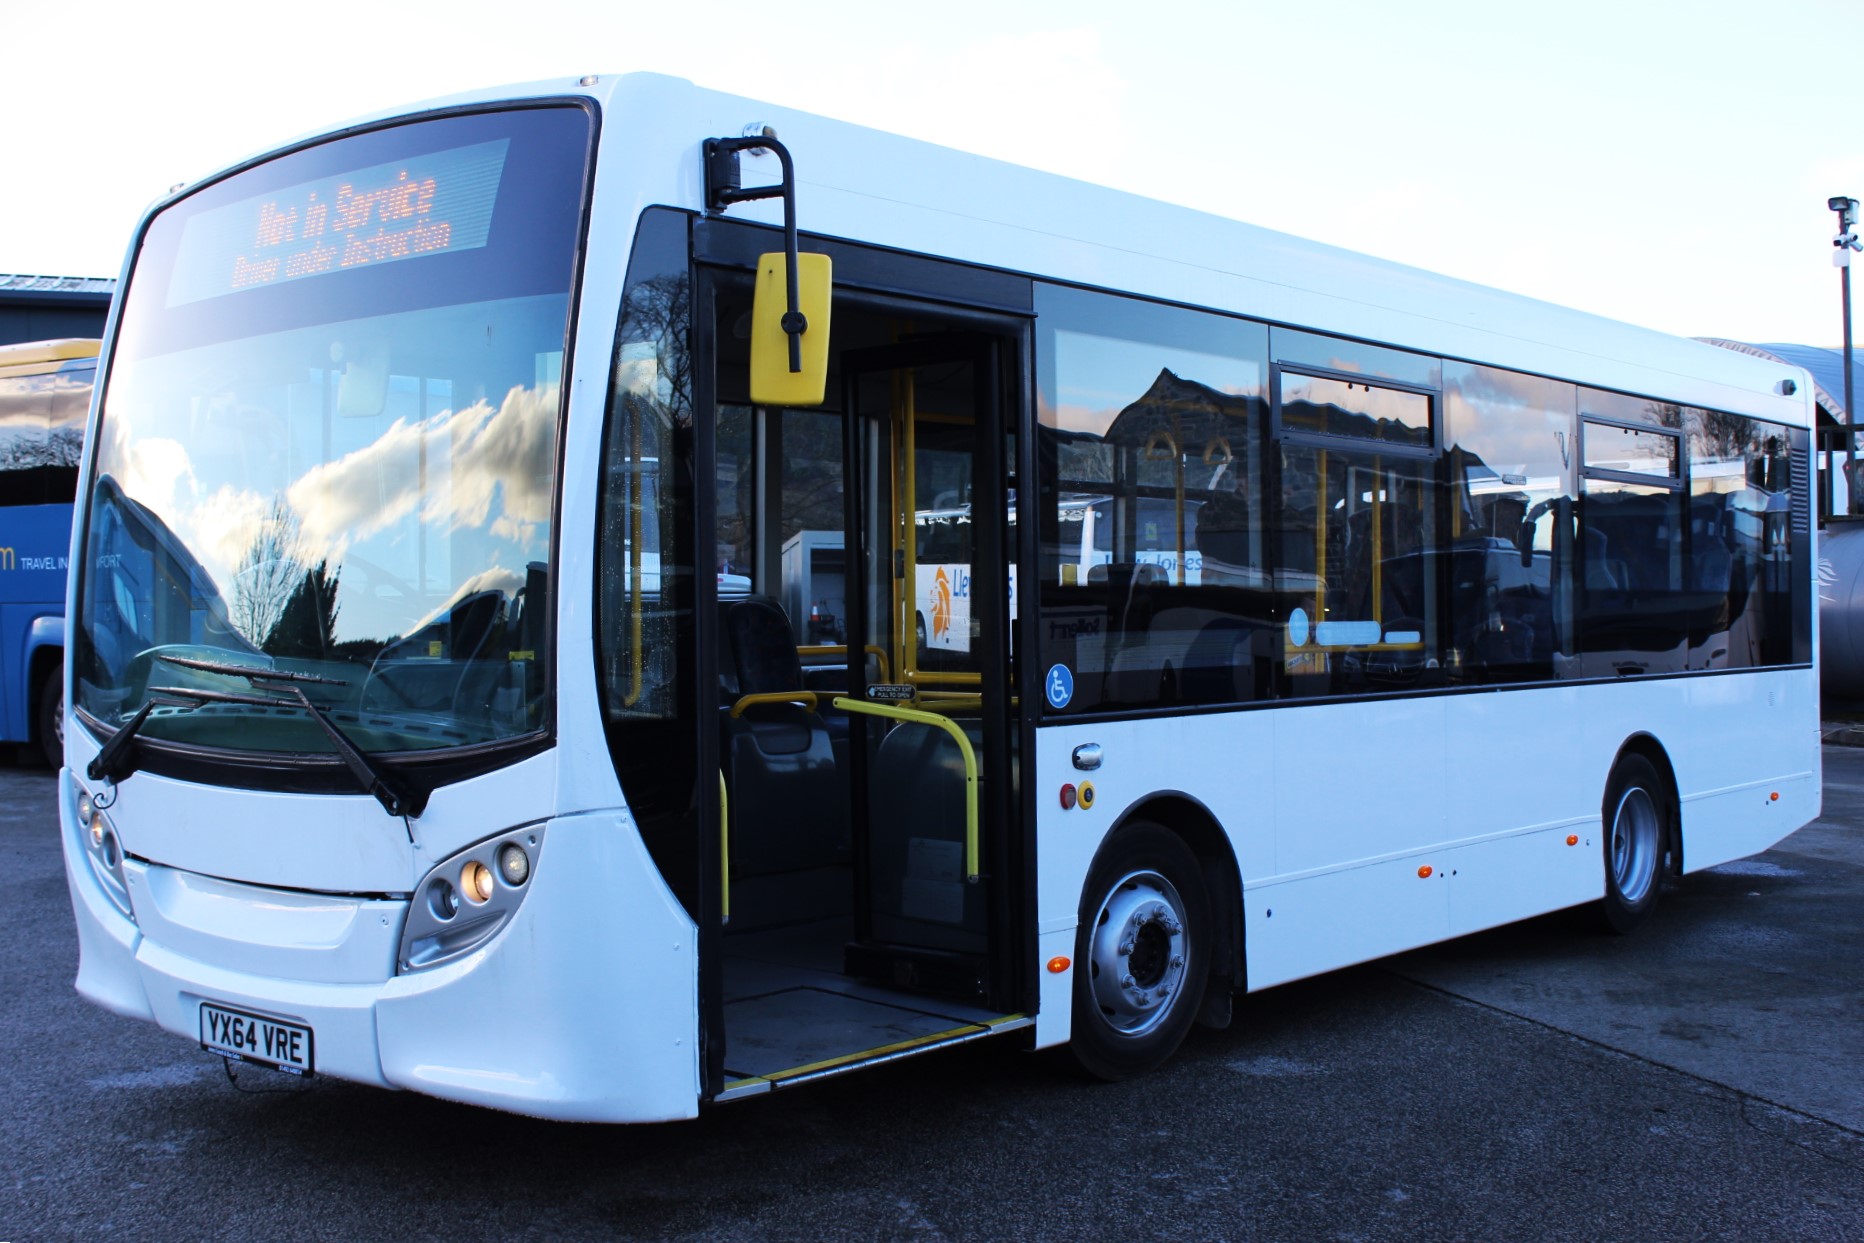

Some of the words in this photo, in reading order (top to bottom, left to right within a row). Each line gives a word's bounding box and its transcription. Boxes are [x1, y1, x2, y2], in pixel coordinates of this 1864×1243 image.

[256, 203, 298, 247] Not
[332, 169, 436, 232] Service
[21, 557, 56, 570] TRAVEL
[58, 556, 69, 569] IN
[208, 1010, 257, 1052] YX64
[263, 1024, 303, 1064] VRE
